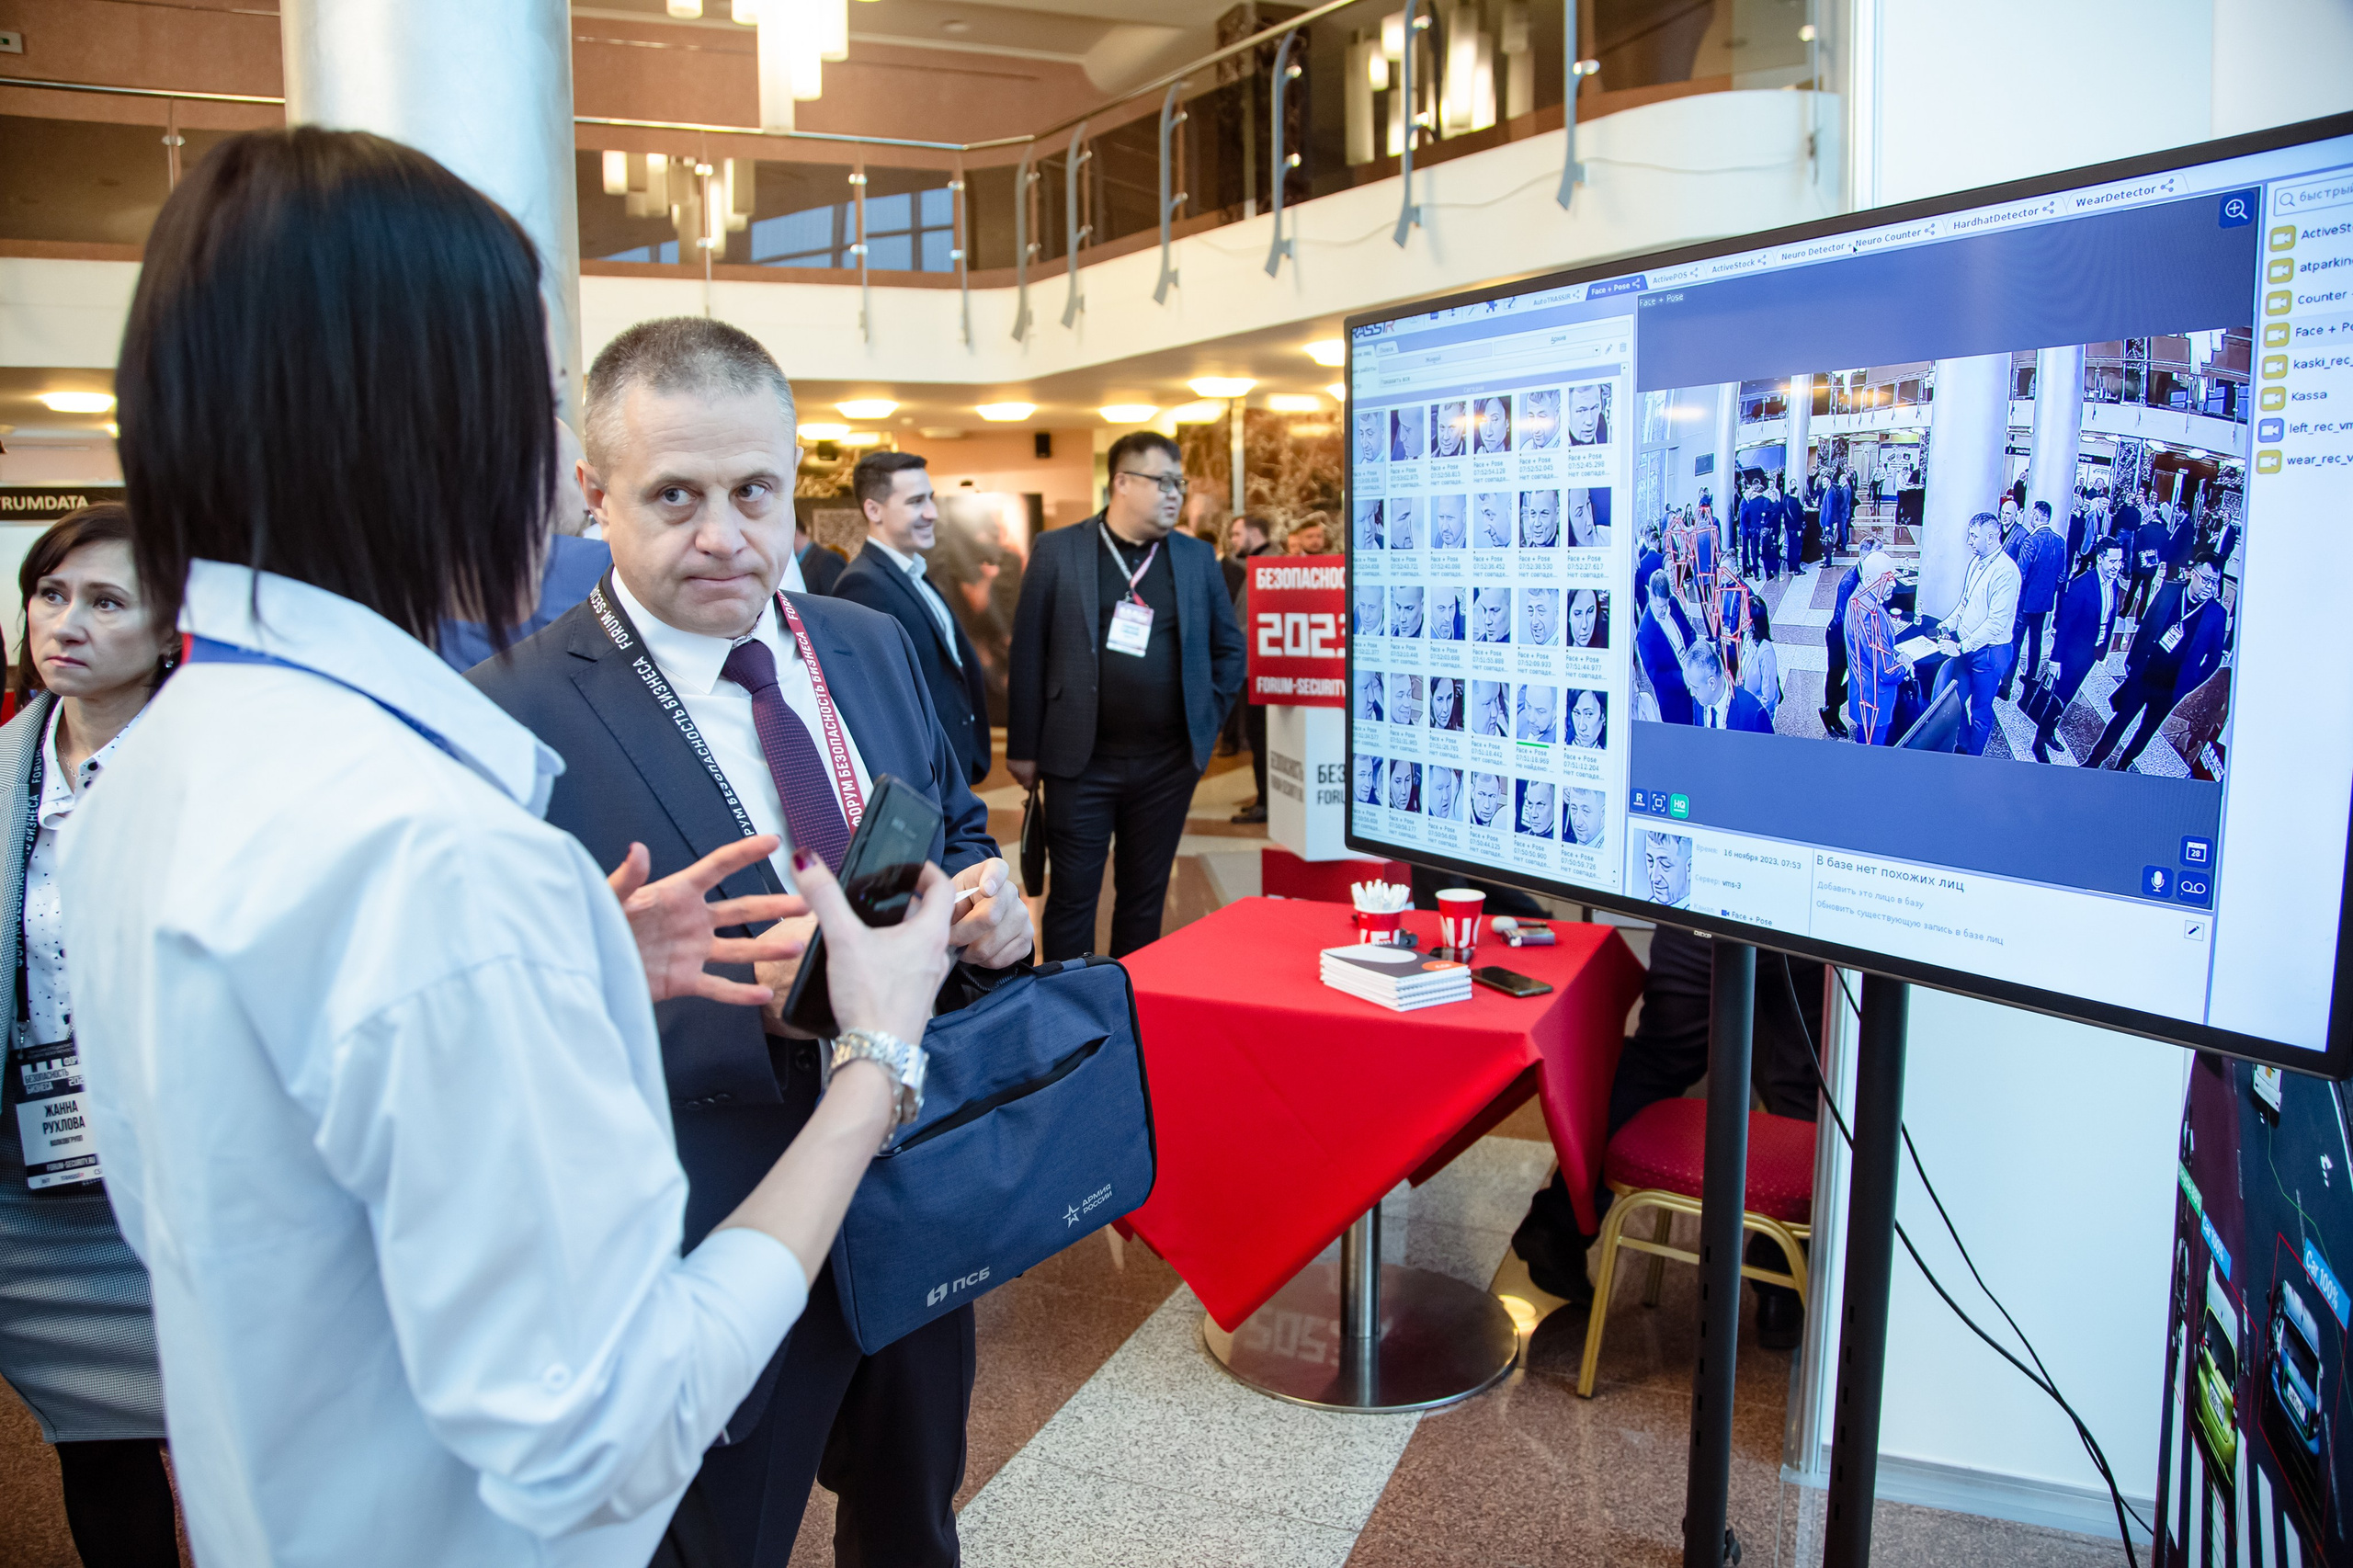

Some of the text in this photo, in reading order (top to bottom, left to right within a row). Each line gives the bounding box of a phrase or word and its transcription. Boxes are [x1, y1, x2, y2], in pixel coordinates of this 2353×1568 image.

[2076, 185, 2156, 207] WearDetector
[1953, 208, 2039, 230] HardhatDetector
[2302, 223, 2353, 240] ActiveSt
[1781, 248, 1806, 260] Neuro
[1809, 243, 1845, 256] Detector
[1856, 237, 1882, 247] Neuro
[1885, 229, 1921, 242] Counter
[1712, 259, 1755, 273] ActiveStock
[1614, 282, 1630, 291] Pose
[1653, 272, 1688, 284] ActivePOS
[1533, 293, 1571, 306] AutoTRASSIR
[1639, 299, 1655, 307] Face
[1666, 294, 1683, 302] Pose
[2298, 291, 2347, 304] Counter
[2296, 327, 2324, 337] Face
[2291, 391, 2327, 401] Kassa
[795, 631, 823, 682] БИЗНЕСА
[632, 655, 678, 710] БИЗНЕСА
[814, 685, 852, 778] БЕЗОПАСНОСТЬ
[673, 709, 738, 805] БЕЗОПАСНОСТЬ
[843, 779, 863, 827] ФОРУМ
[1636, 793, 1643, 802] R
[1675, 799, 1685, 809] HQ
[1734, 852, 1758, 862] ноября
[1760, 856, 1779, 866] 2023,
[1781, 859, 1802, 869] 07:53
[1816, 855, 1965, 892] В базе нет похожих лиц
[1722, 880, 1742, 889] vms-3
[1817, 881, 1856, 895] Добавить
[1859, 890, 1873, 899] это
[1875, 892, 1895, 904] лицо
[1905, 897, 1924, 909] базу
[1732, 911, 1746, 920] Face
[1756, 916, 1772, 926] Pose
[1816, 900, 1855, 914] Обновить
[1857, 909, 1921, 928] существующую
[1924, 923, 1953, 935] запись
[1963, 929, 1984, 940] базе
[1986, 935, 2004, 946] лиц
[44, 1100, 79, 1118] ЖАННА
[42, 1116, 85, 1134] РУХЛОВА
[1082, 1183, 1111, 1207] АРМИЯ
[1083, 1189, 1112, 1214] РОССИИ
[952, 1267, 990, 1293] ПСБ
[2306, 1250, 2338, 1310] Car 100%
